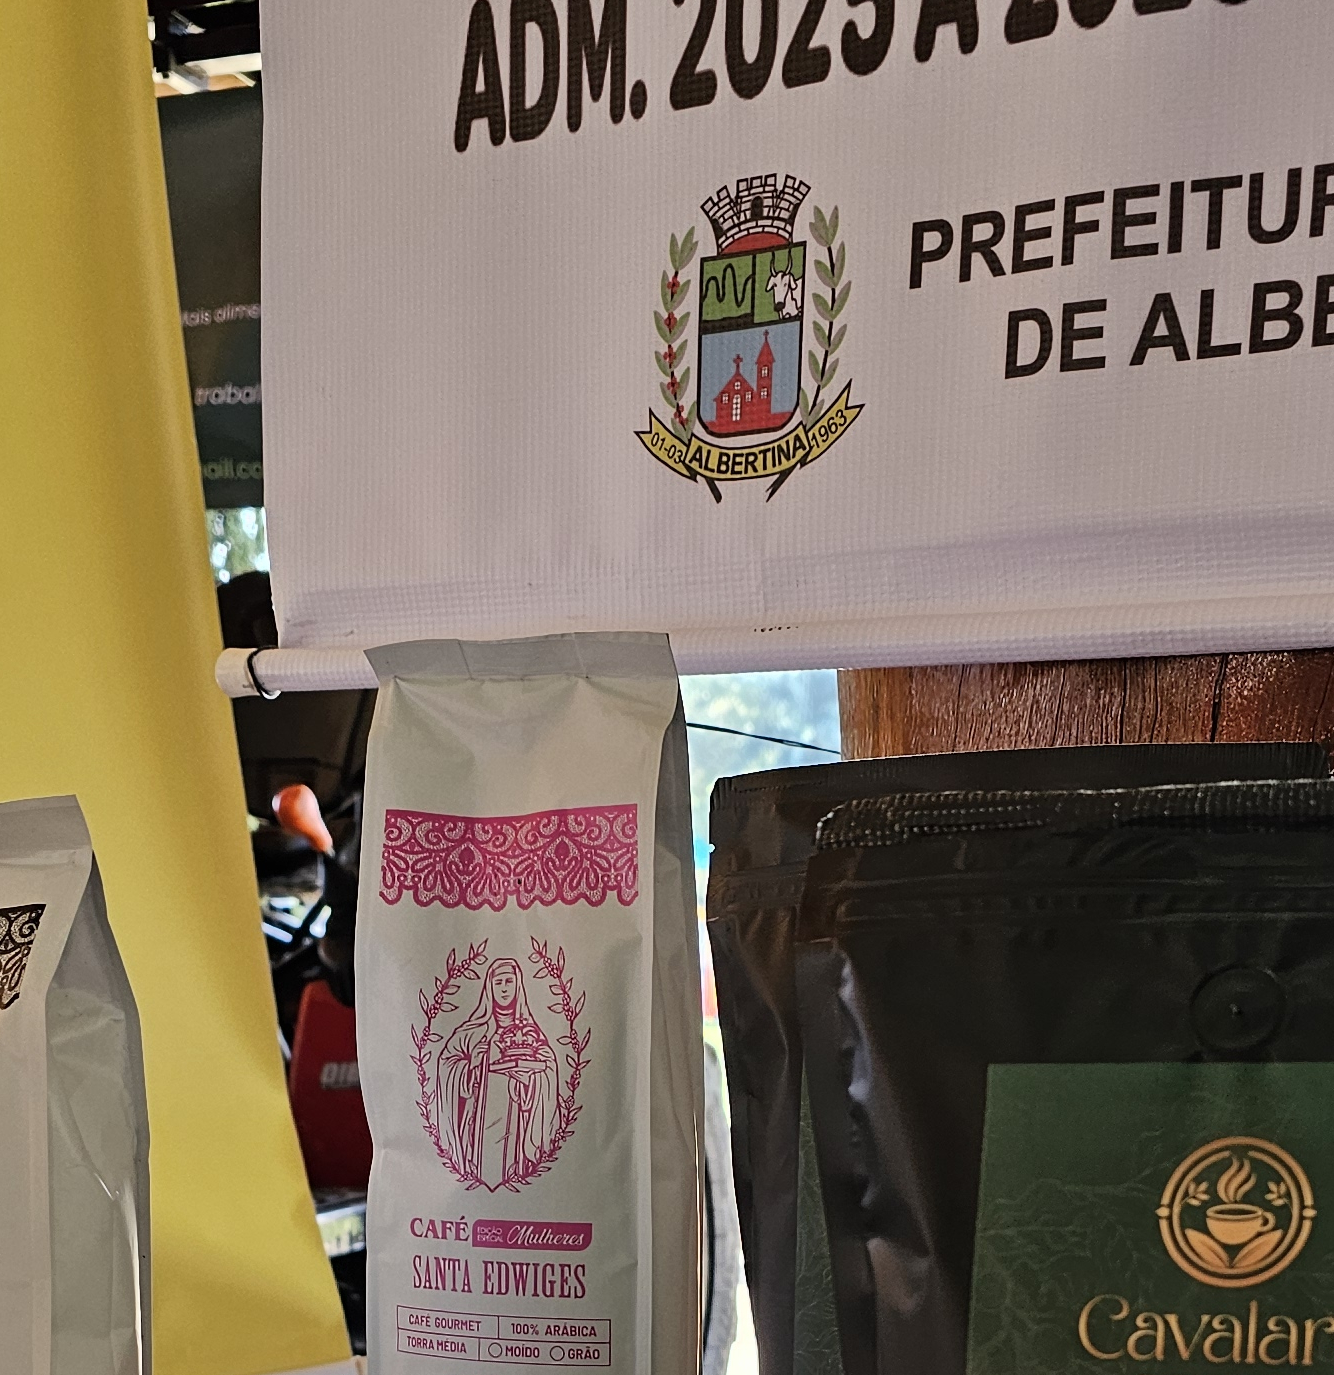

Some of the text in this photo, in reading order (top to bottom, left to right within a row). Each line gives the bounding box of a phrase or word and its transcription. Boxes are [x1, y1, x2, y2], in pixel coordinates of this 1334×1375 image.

[453, 0, 649, 153] ADM.
[1004, 298, 1108, 379] DE
[651, 432, 684, 464] 01-03
[688, 432, 807, 475] ALBERTINA
[409, 1215, 469, 1242] CAFÉ
[506, 1224, 585, 1247] Mulheres
[412, 1255, 586, 1299] SANTA EDWIGES
[408, 1313, 482, 1332] CAFÉ GOURMET
[511, 1322, 597, 1337] 100% ARÁBICA
[407, 1335, 467, 1354] TORRA MÉDIA
[505, 1344, 540, 1358] MOÍDO
[568, 1345, 601, 1360] GRÃO
